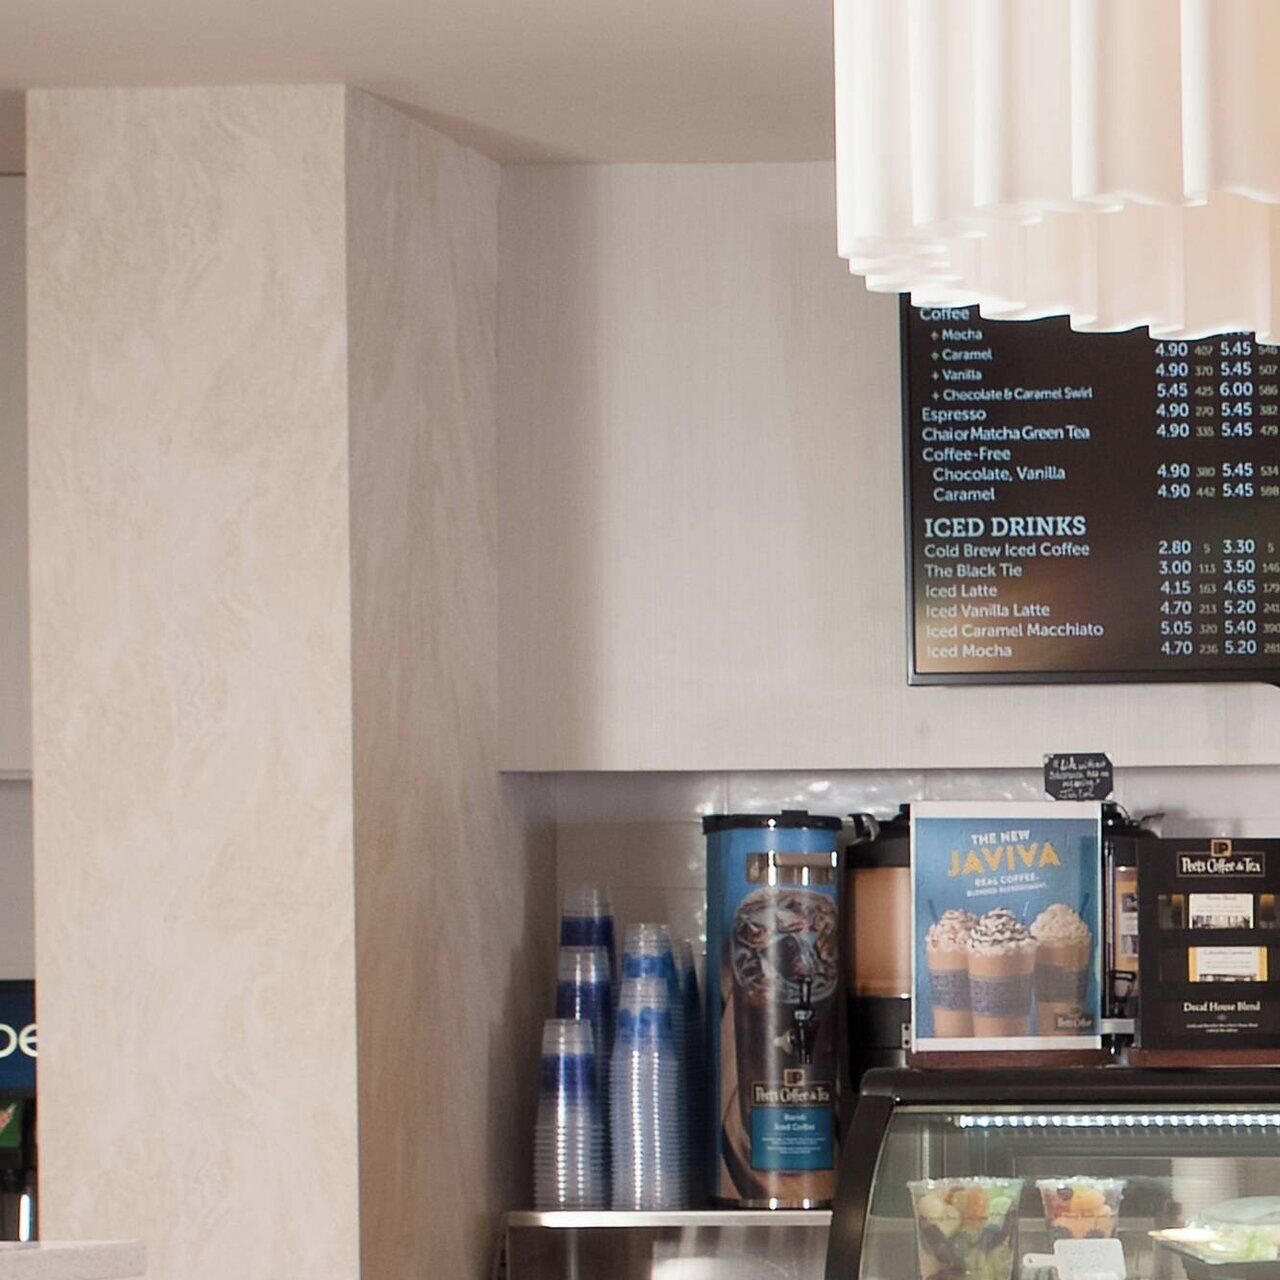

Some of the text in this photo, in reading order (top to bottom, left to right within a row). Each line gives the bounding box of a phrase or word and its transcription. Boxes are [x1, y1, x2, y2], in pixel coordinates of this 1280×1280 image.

[922, 408, 986, 424] Espresso
[923, 447, 1011, 461] Coffee-Free
[933, 466, 1065, 481] Chocolate, Vanilla
[934, 487, 995, 501] Caramel
[925, 516, 1086, 537] ICED DRINKS
[925, 539, 1255, 558] Cold Brew Iced Coffee 2.80 3.30
[925, 563, 1022, 578] The Black Tie
[926, 584, 998, 597] Iced Latte
[926, 603, 1050, 618] Iced Vanilla Latte
[927, 623, 1103, 637] Iced Caramel Macchiato
[928, 644, 1012, 658] Iced Mocha
[971, 830, 1030, 845] THE NEW
[948, 842, 1061, 877] JAVIVA
[1207, 857, 1235, 874] Coffee
[1243, 857, 1261, 872] Tea
[974, 876, 998, 887] REAL
[1183, 1001, 1261, 1012] Decaf House Blend
